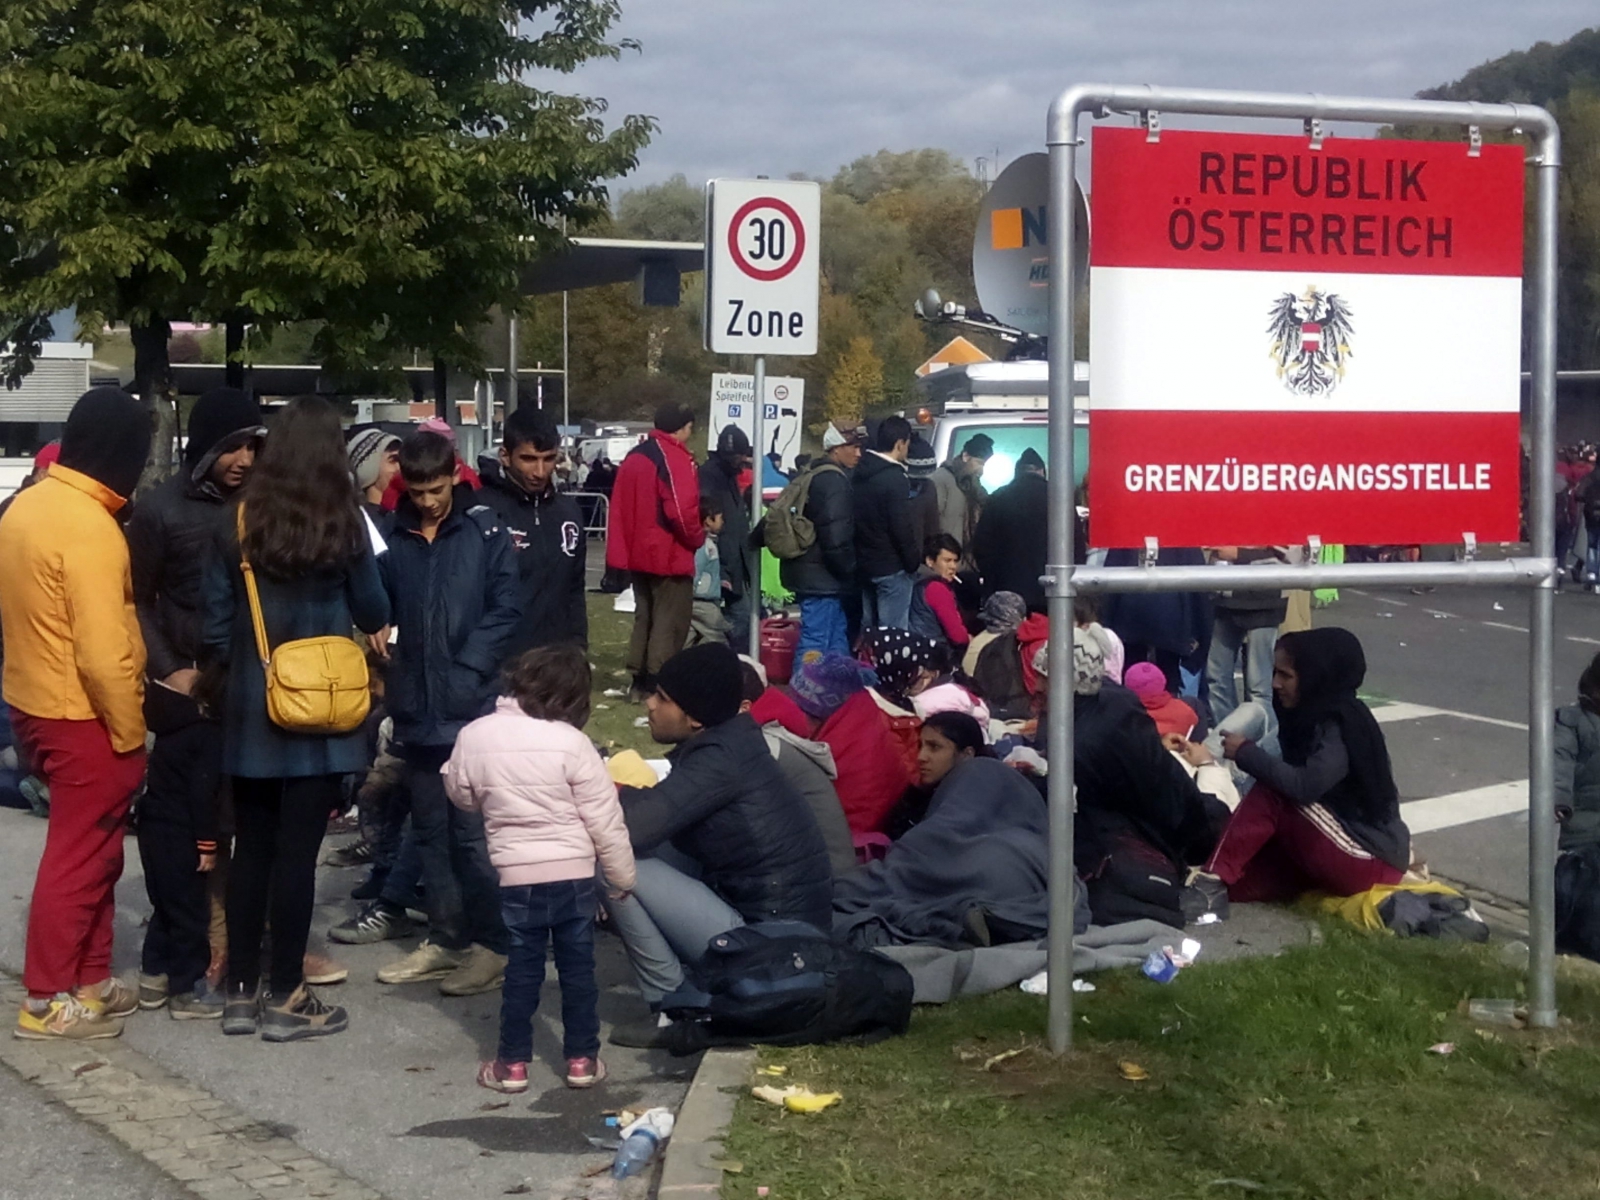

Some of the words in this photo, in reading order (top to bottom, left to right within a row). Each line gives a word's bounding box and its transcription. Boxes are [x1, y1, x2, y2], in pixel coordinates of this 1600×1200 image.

[1199, 151, 1429, 203] REPUBLIK
[748, 217, 786, 261] 30
[1169, 196, 1453, 258] ÖSTERREICH
[726, 299, 804, 338] Zone
[729, 406, 740, 416] 67
[1124, 458, 1491, 493] GRENZÜBERGANGSSTELLE
